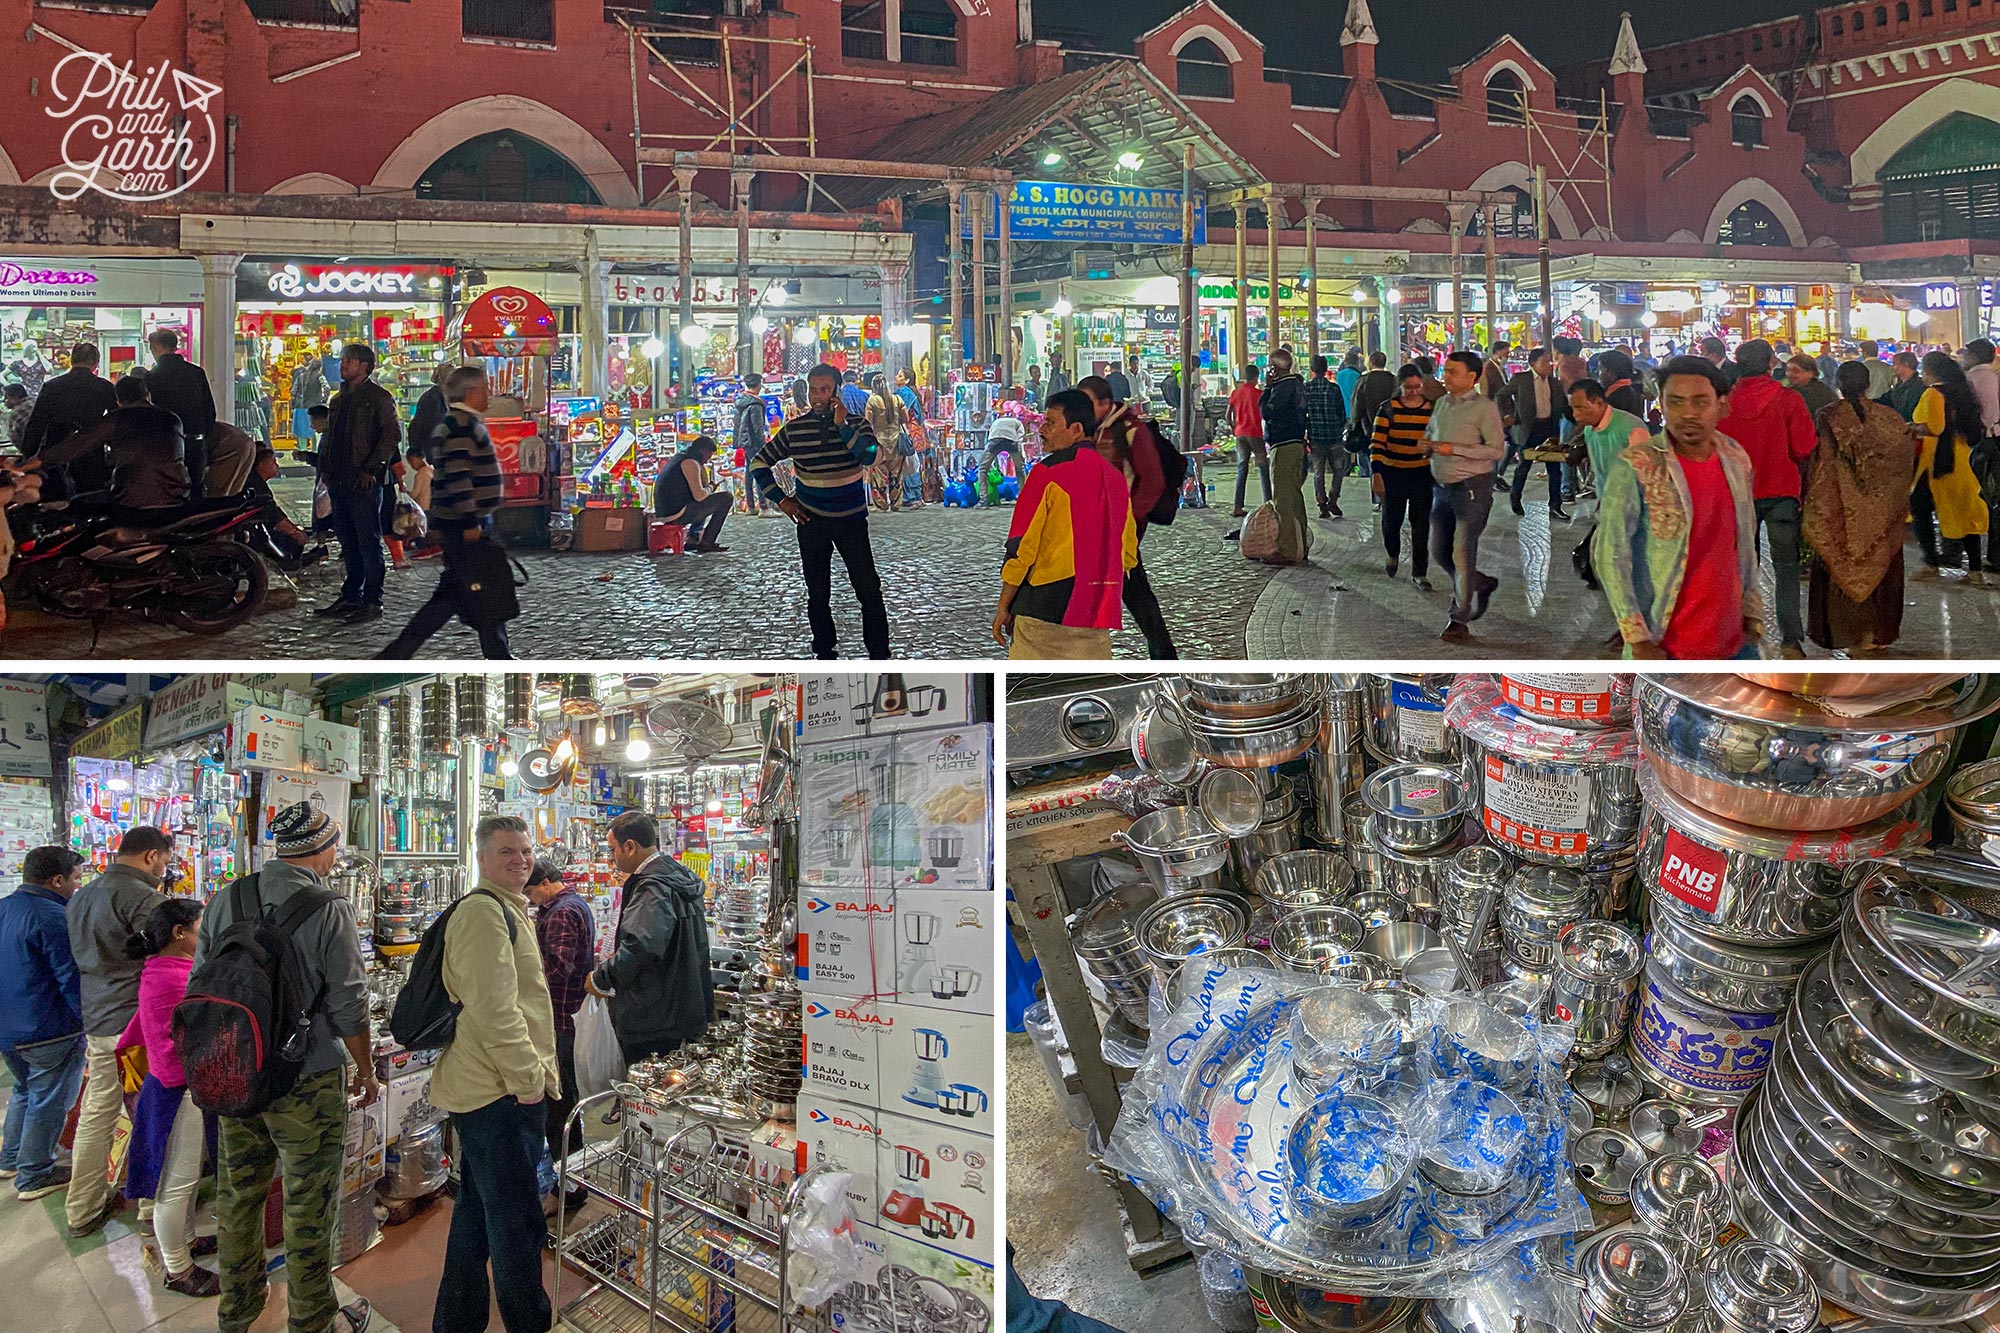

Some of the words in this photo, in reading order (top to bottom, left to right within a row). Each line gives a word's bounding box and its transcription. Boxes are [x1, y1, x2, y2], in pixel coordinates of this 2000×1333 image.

[1030, 186, 1049, 203] S.
[1054, 187, 1114, 205] HOGG
[1119, 190, 1203, 209] MARKT
[1010, 206, 1030, 214] THE
[1033, 207, 1078, 216] KOLKATA
[1081, 208, 1134, 218] MUNICIPAL
[306, 271, 413, 293] JOCKEY
[33, 289, 68, 297] Ultimate
[70, 289, 96, 297] Desire
[1154, 313, 1177, 321] OLAY
[154, 681, 207, 719] BENGAL
[808, 710, 836, 720] BAJAJ
[822, 716, 841, 724] 3701
[927, 750, 980, 764] FAMILY
[935, 760, 977, 770] MATE
[1488, 764, 1502, 776] PNB
[1503, 777, 1536, 793] ROMANO
[1538, 788, 1579, 798] STEWPAN
[1026, 811, 1067, 827] KITCHEN
[1665, 854, 1717, 893] PNB
[1663, 871, 1712, 902] Kitchenmate
[835, 902, 894, 913] BAJAJ
[835, 912, 868, 922] Inspiring
[815, 963, 843, 971] BAJAJ
[815, 970, 839, 978] EASY
[835, 1009, 894, 1026] BAJAJ
[868, 1024, 893, 1035] Trust
[812, 1064, 845, 1077] BAJAJ
[812, 1072, 847, 1086] BRAVO
[850, 1081, 870, 1091] DLX
[833, 1117, 882, 1135] BAJAJ
